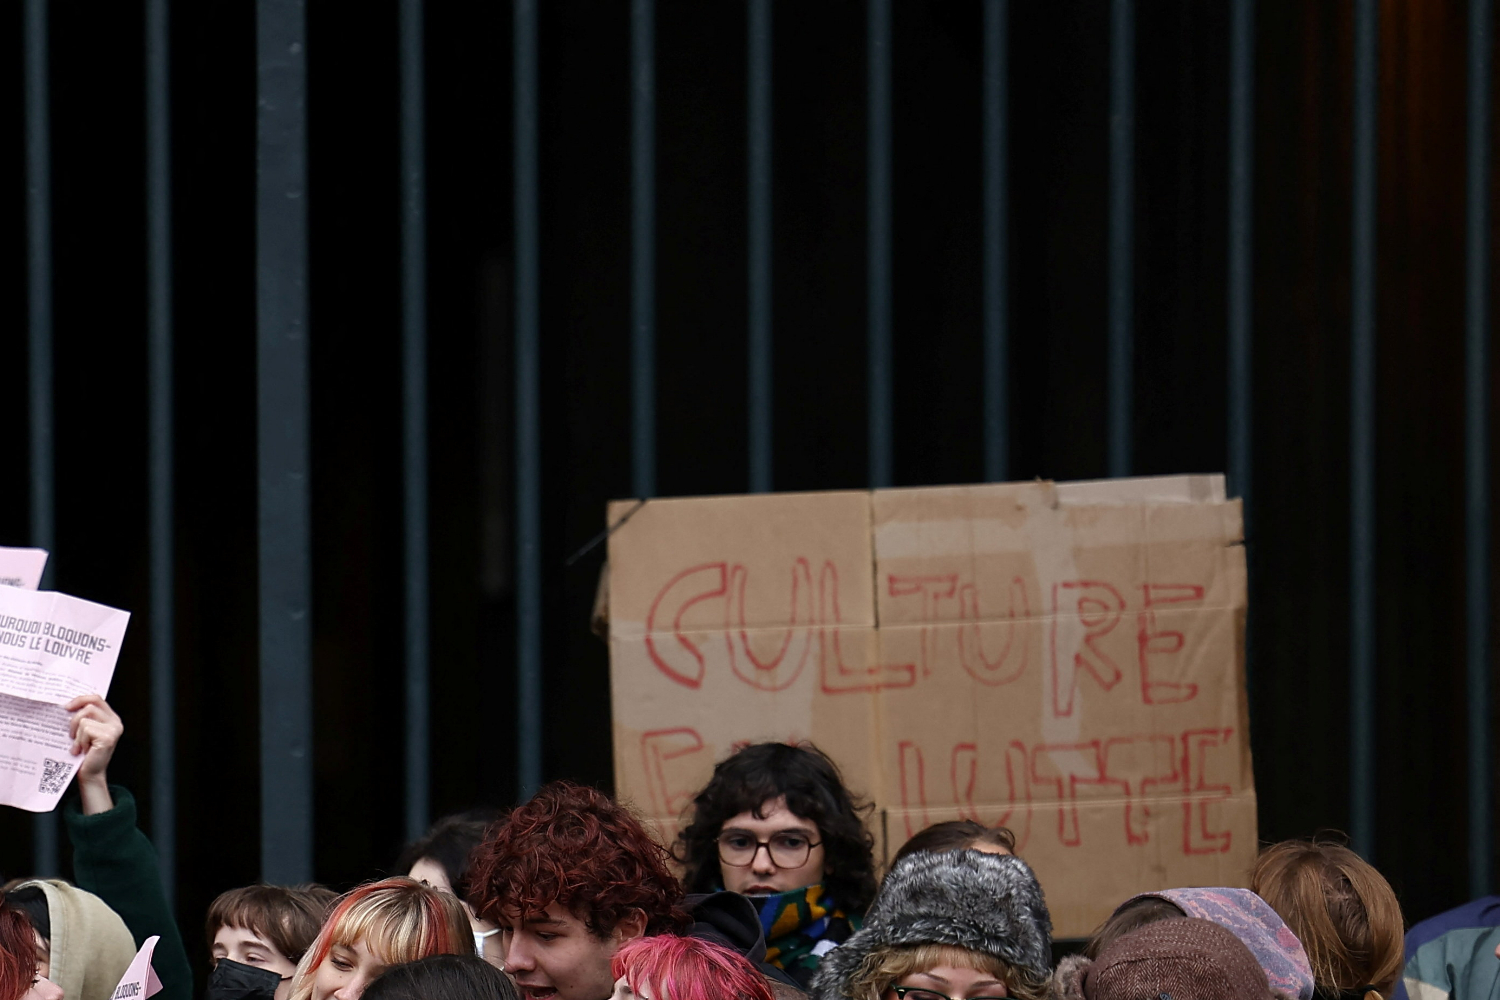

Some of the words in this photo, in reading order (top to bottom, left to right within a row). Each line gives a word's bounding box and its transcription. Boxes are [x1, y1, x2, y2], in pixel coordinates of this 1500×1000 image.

[29, 636, 43, 650] LE
[44, 638, 93, 665] LOUVRE
[42, 622, 112, 652] BLOQUONS-
[646, 557, 1205, 718] CULTURE
[114, 981, 142, 1000] BLOQUONS-
